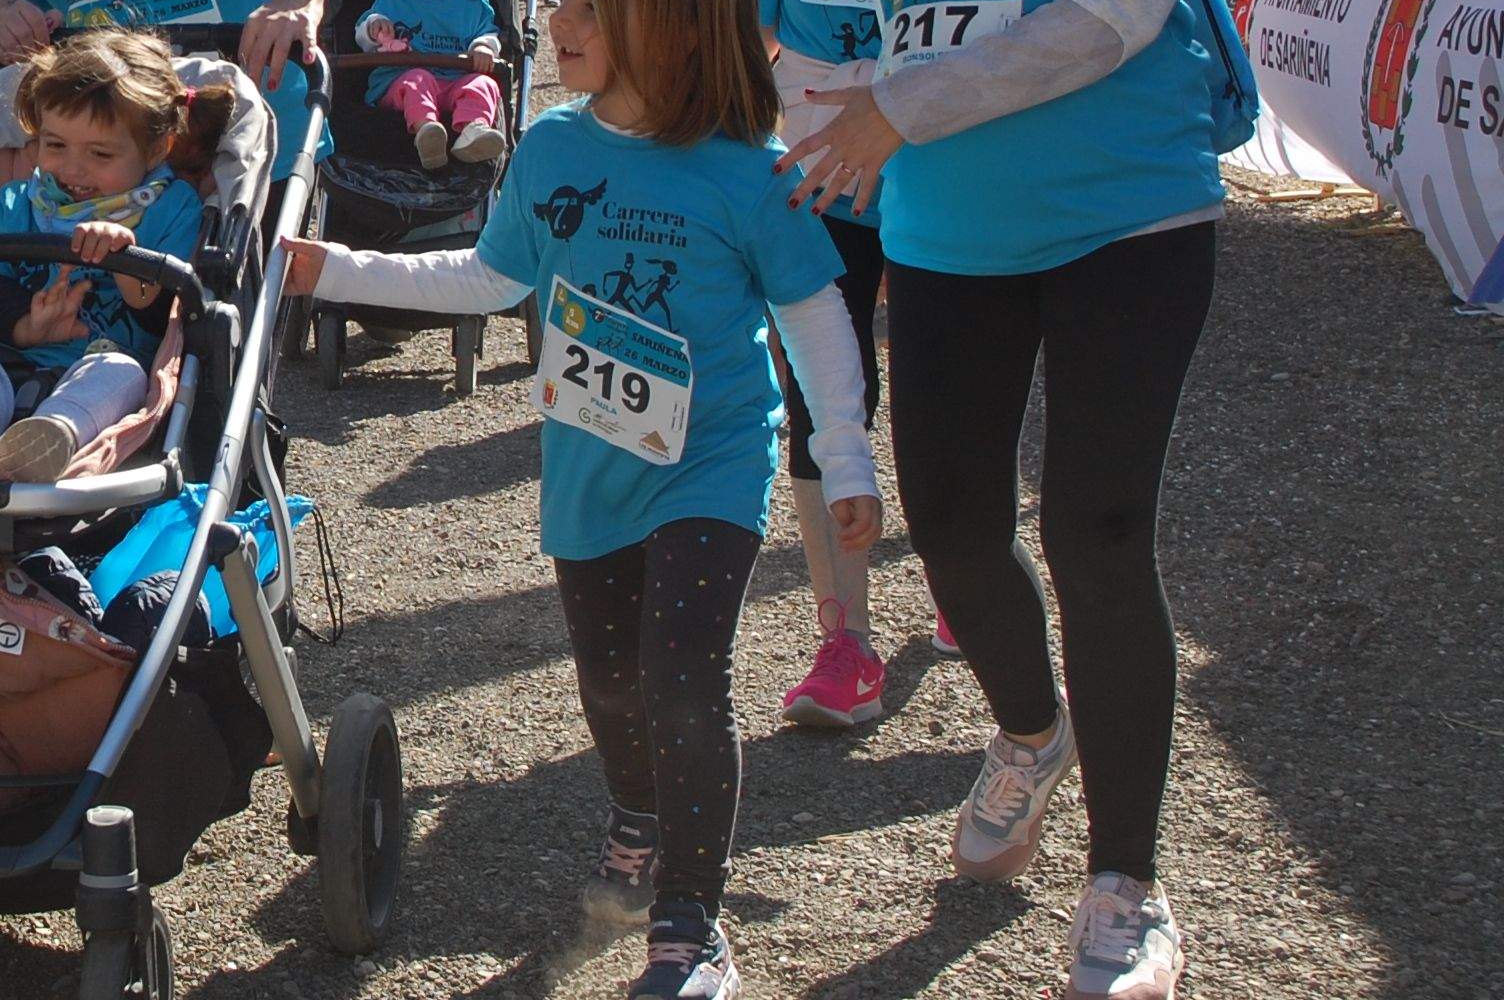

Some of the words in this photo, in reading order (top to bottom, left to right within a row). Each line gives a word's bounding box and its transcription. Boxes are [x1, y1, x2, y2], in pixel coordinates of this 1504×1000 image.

[892, 4, 979, 57] 217
[1260, 27, 1274, 68] DE
[1437, 75, 1473, 129] DE
[597, 222, 687, 248] solidaria
[602, 201, 685, 228] Carrera
[562, 343, 651, 414] 219
[623, 347, 639, 361] 26
[643, 354, 687, 380] MARZO
